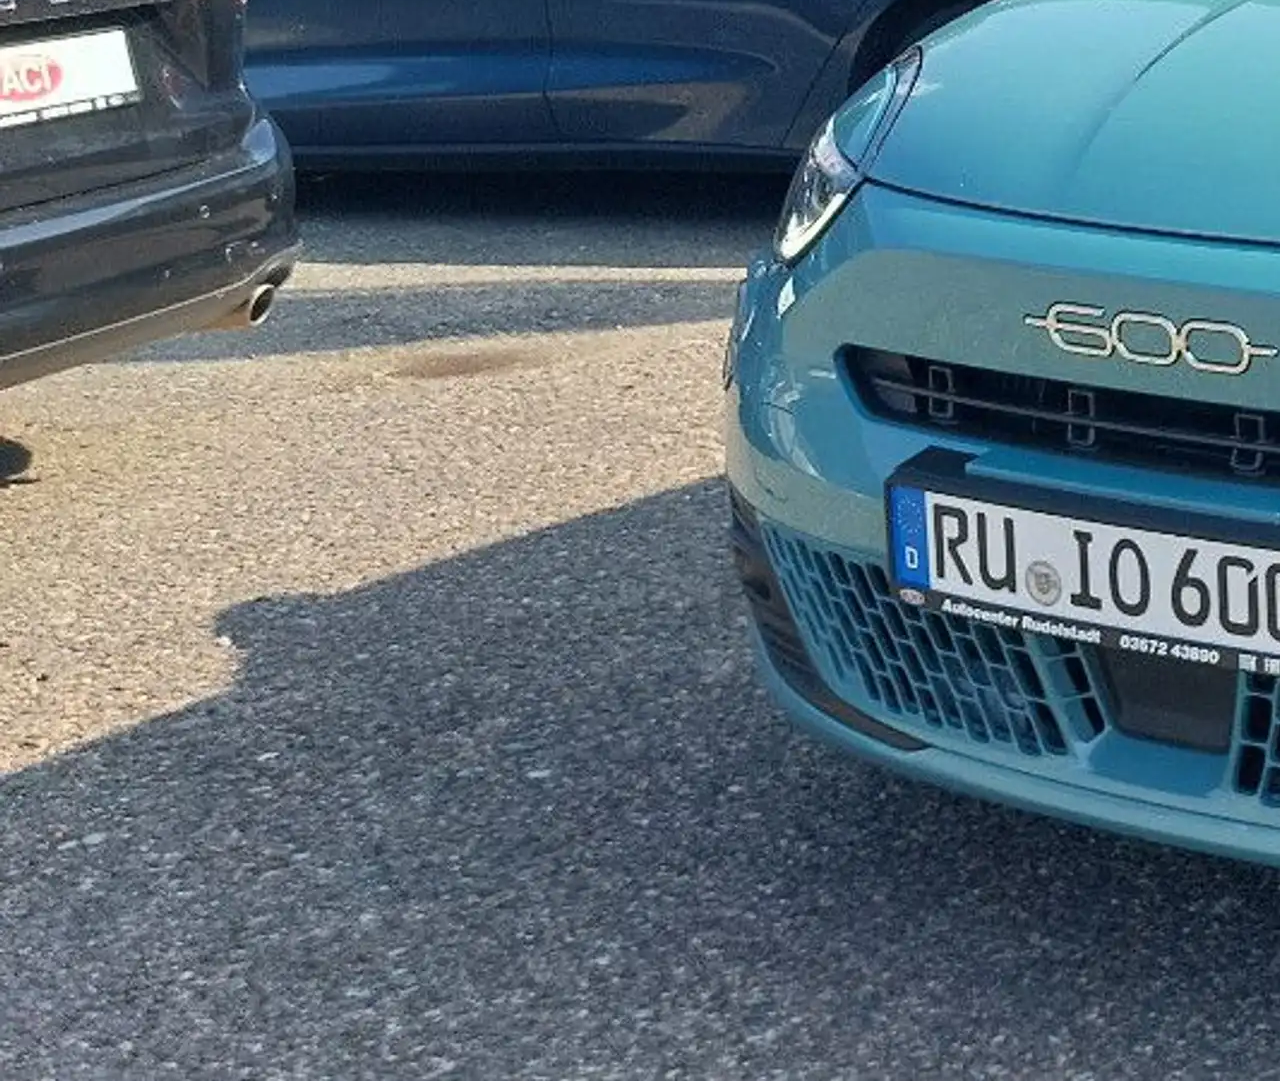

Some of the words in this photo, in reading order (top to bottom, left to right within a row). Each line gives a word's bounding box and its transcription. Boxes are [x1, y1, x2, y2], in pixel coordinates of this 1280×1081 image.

[1044, 301, 1253, 376] 600
[904, 546, 919, 570] D
[932, 502, 1017, 594] RU
[1069, 528, 1152, 618] IO
[941, 598, 1020, 627] Autocenter
